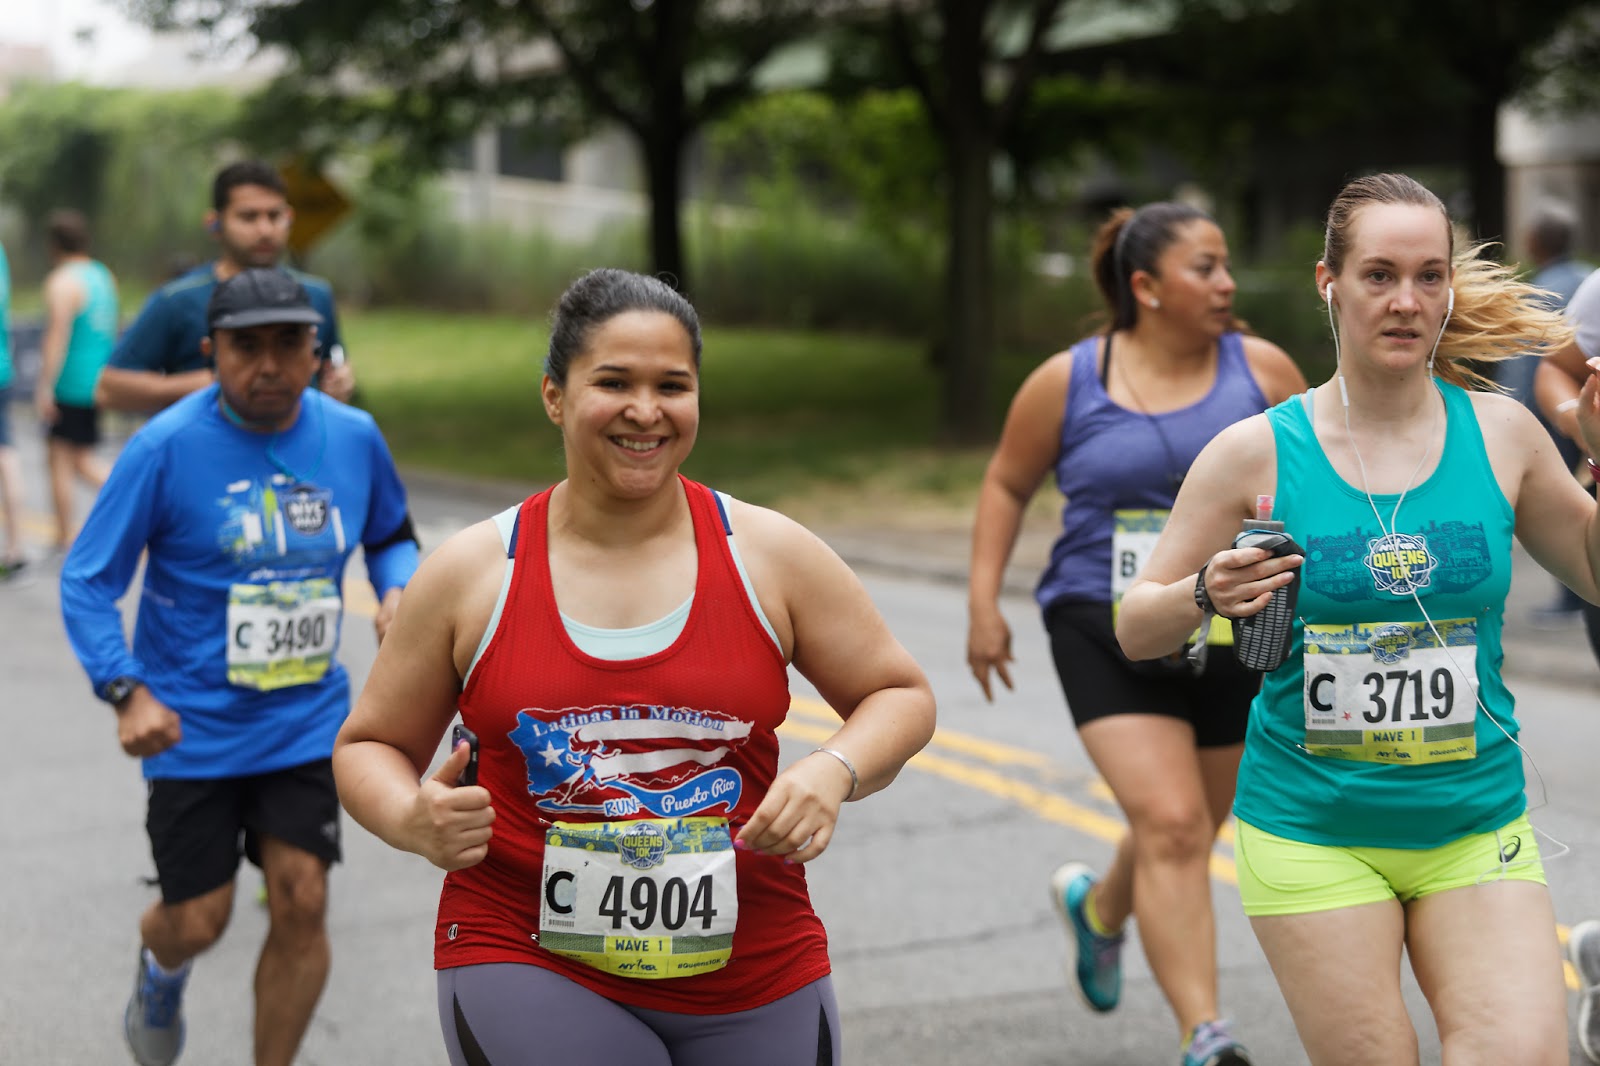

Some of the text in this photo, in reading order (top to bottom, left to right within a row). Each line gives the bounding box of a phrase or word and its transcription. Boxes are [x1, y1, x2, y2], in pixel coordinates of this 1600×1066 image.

[1120, 551, 1136, 578] B
[1373, 550, 1427, 568] QUEENS
[235, 615, 325, 654] C 3490
[1309, 672, 1336, 712] C
[1362, 667, 1454, 723] 3719
[532, 706, 726, 737] Latinas in Motion
[1372, 731, 1403, 742] WAVE
[604, 778, 736, 817] RUN Puerto Rico
[623, 836, 663, 847] QUEENS
[635, 847, 651, 858] 10K
[546, 871, 575, 914] C
[598, 874, 718, 930] 4904
[615, 938, 663, 951] WAVE 1
